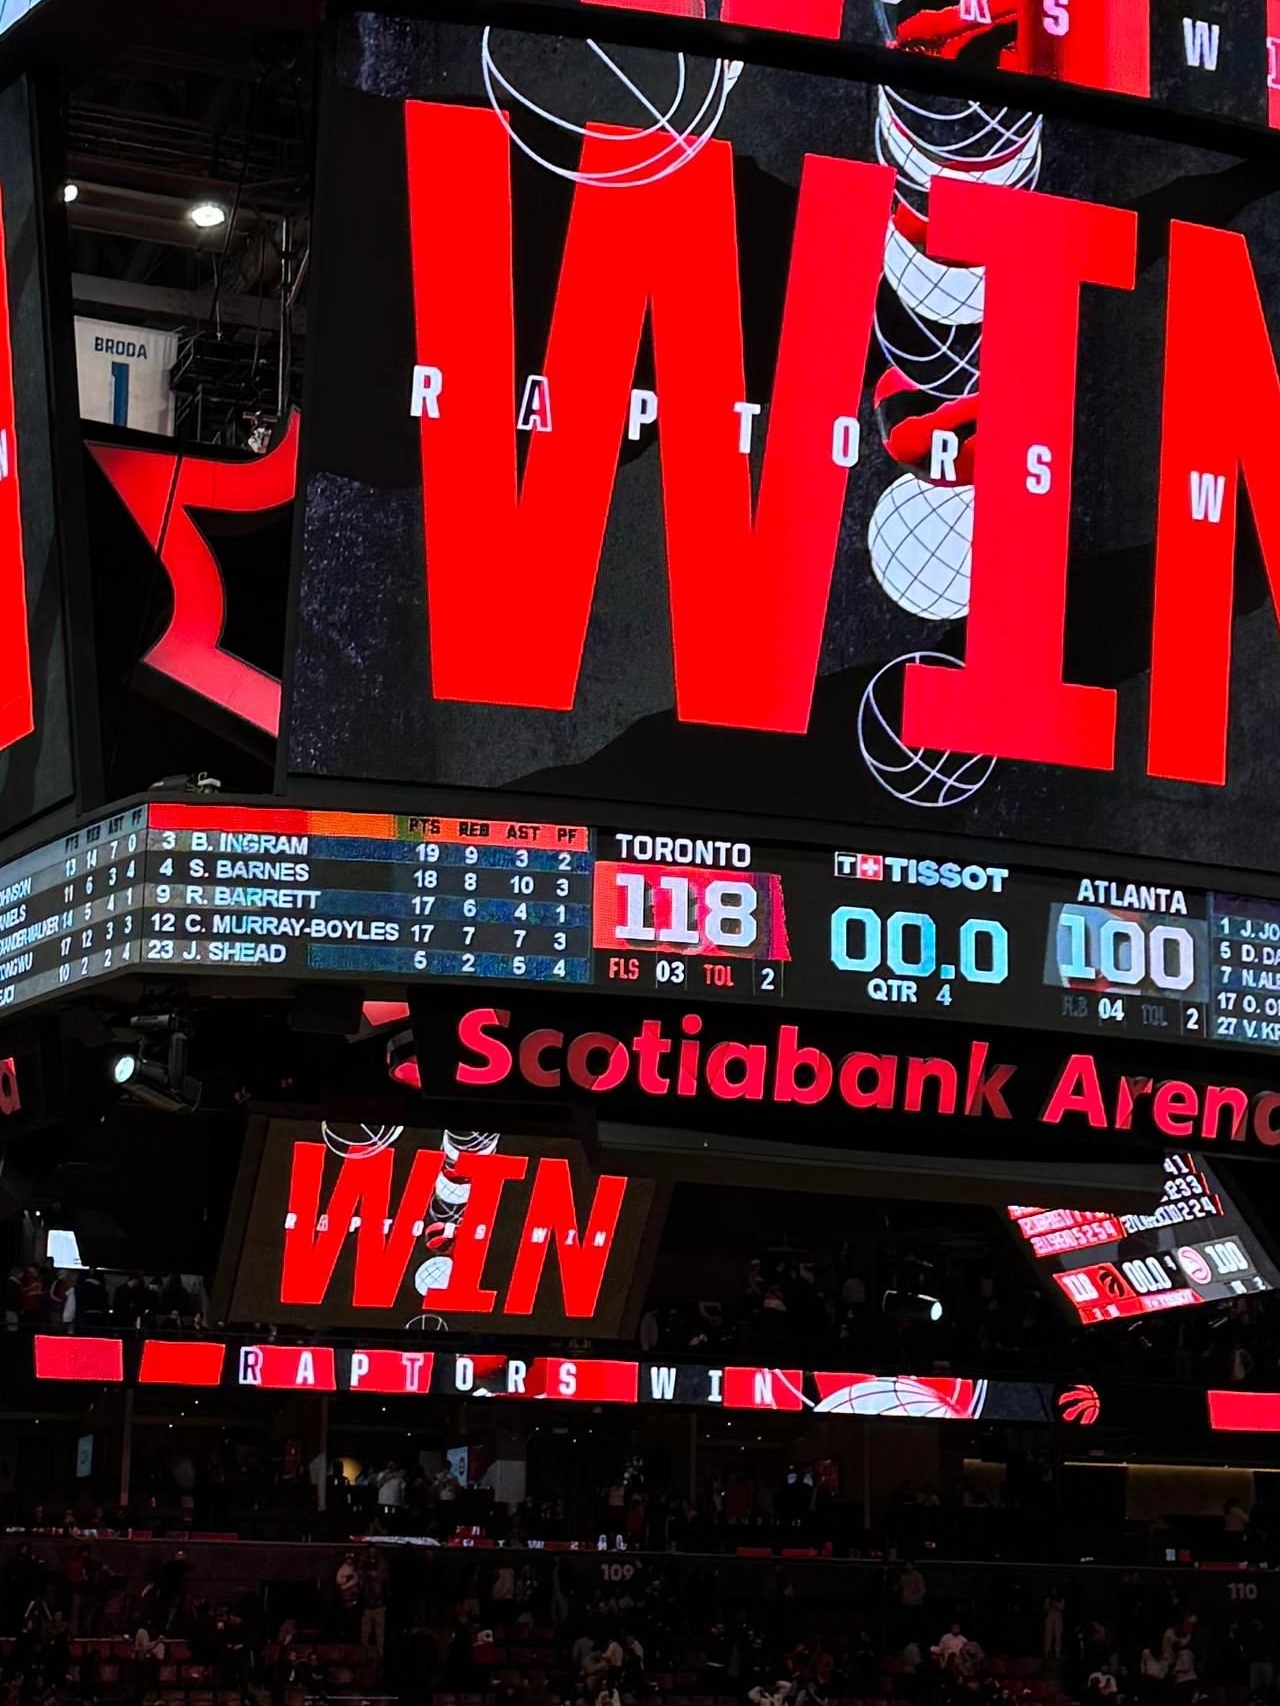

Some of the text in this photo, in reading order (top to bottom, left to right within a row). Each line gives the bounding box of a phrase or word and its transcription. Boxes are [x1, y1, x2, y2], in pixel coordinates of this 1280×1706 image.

[94, 335, 149, 361] BRODA
[111, 361, 130, 427] 1
[409, 364, 1051, 493] RAPTORS
[162, 832, 571, 870] 3 B. INGRAM 19 9 3 2
[616, 833, 751, 868] TORONTO
[159, 859, 569, 897] 4 S. BARNES 18 8 10 3
[885, 857, 1009, 892] TISSOT
[157, 886, 566, 922] 9 R. BARRETT 17 6 4 1
[615, 873, 757, 948] 118
[1077, 879, 1187, 915] ATLANTA
[151, 913, 566, 950] 12 C. MURRAY-BOYLES 17 7 7 3
[830, 905, 1009, 985] 00.0
[1221, 918, 1229, 934] 1
[1240, 920, 1256, 938] J.
[148, 940, 566, 978] 23 J. SHEAD 5 2 5 4
[1059, 912, 1194, 990] 100
[1220, 942, 1230, 959] 5
[1241, 944, 1258, 963] D.
[609, 958, 775, 991] FLS 03 TOL 2
[867, 977, 952, 1007] QTR 4
[1221, 966, 1232, 983] 7
[1241, 968, 1257, 988] N.
[1098, 997, 1125, 1021] 04
[1186, 1007, 1200, 1031] 2
[1217, 991, 1236, 1010] 17
[1242, 995, 1260, 1015] O.
[1217, 1016, 1237, 1035] 27
[1242, 1020, 1257, 1039] V.
[455, 1008, 1014, 1121] Scotiabank
[281, 1142, 628, 1317] WIN
[239, 1346, 774, 1406] RAPTORS WIN
[601, 1564, 634, 1581] 109
[1228, 1582, 1257, 1600] 110
